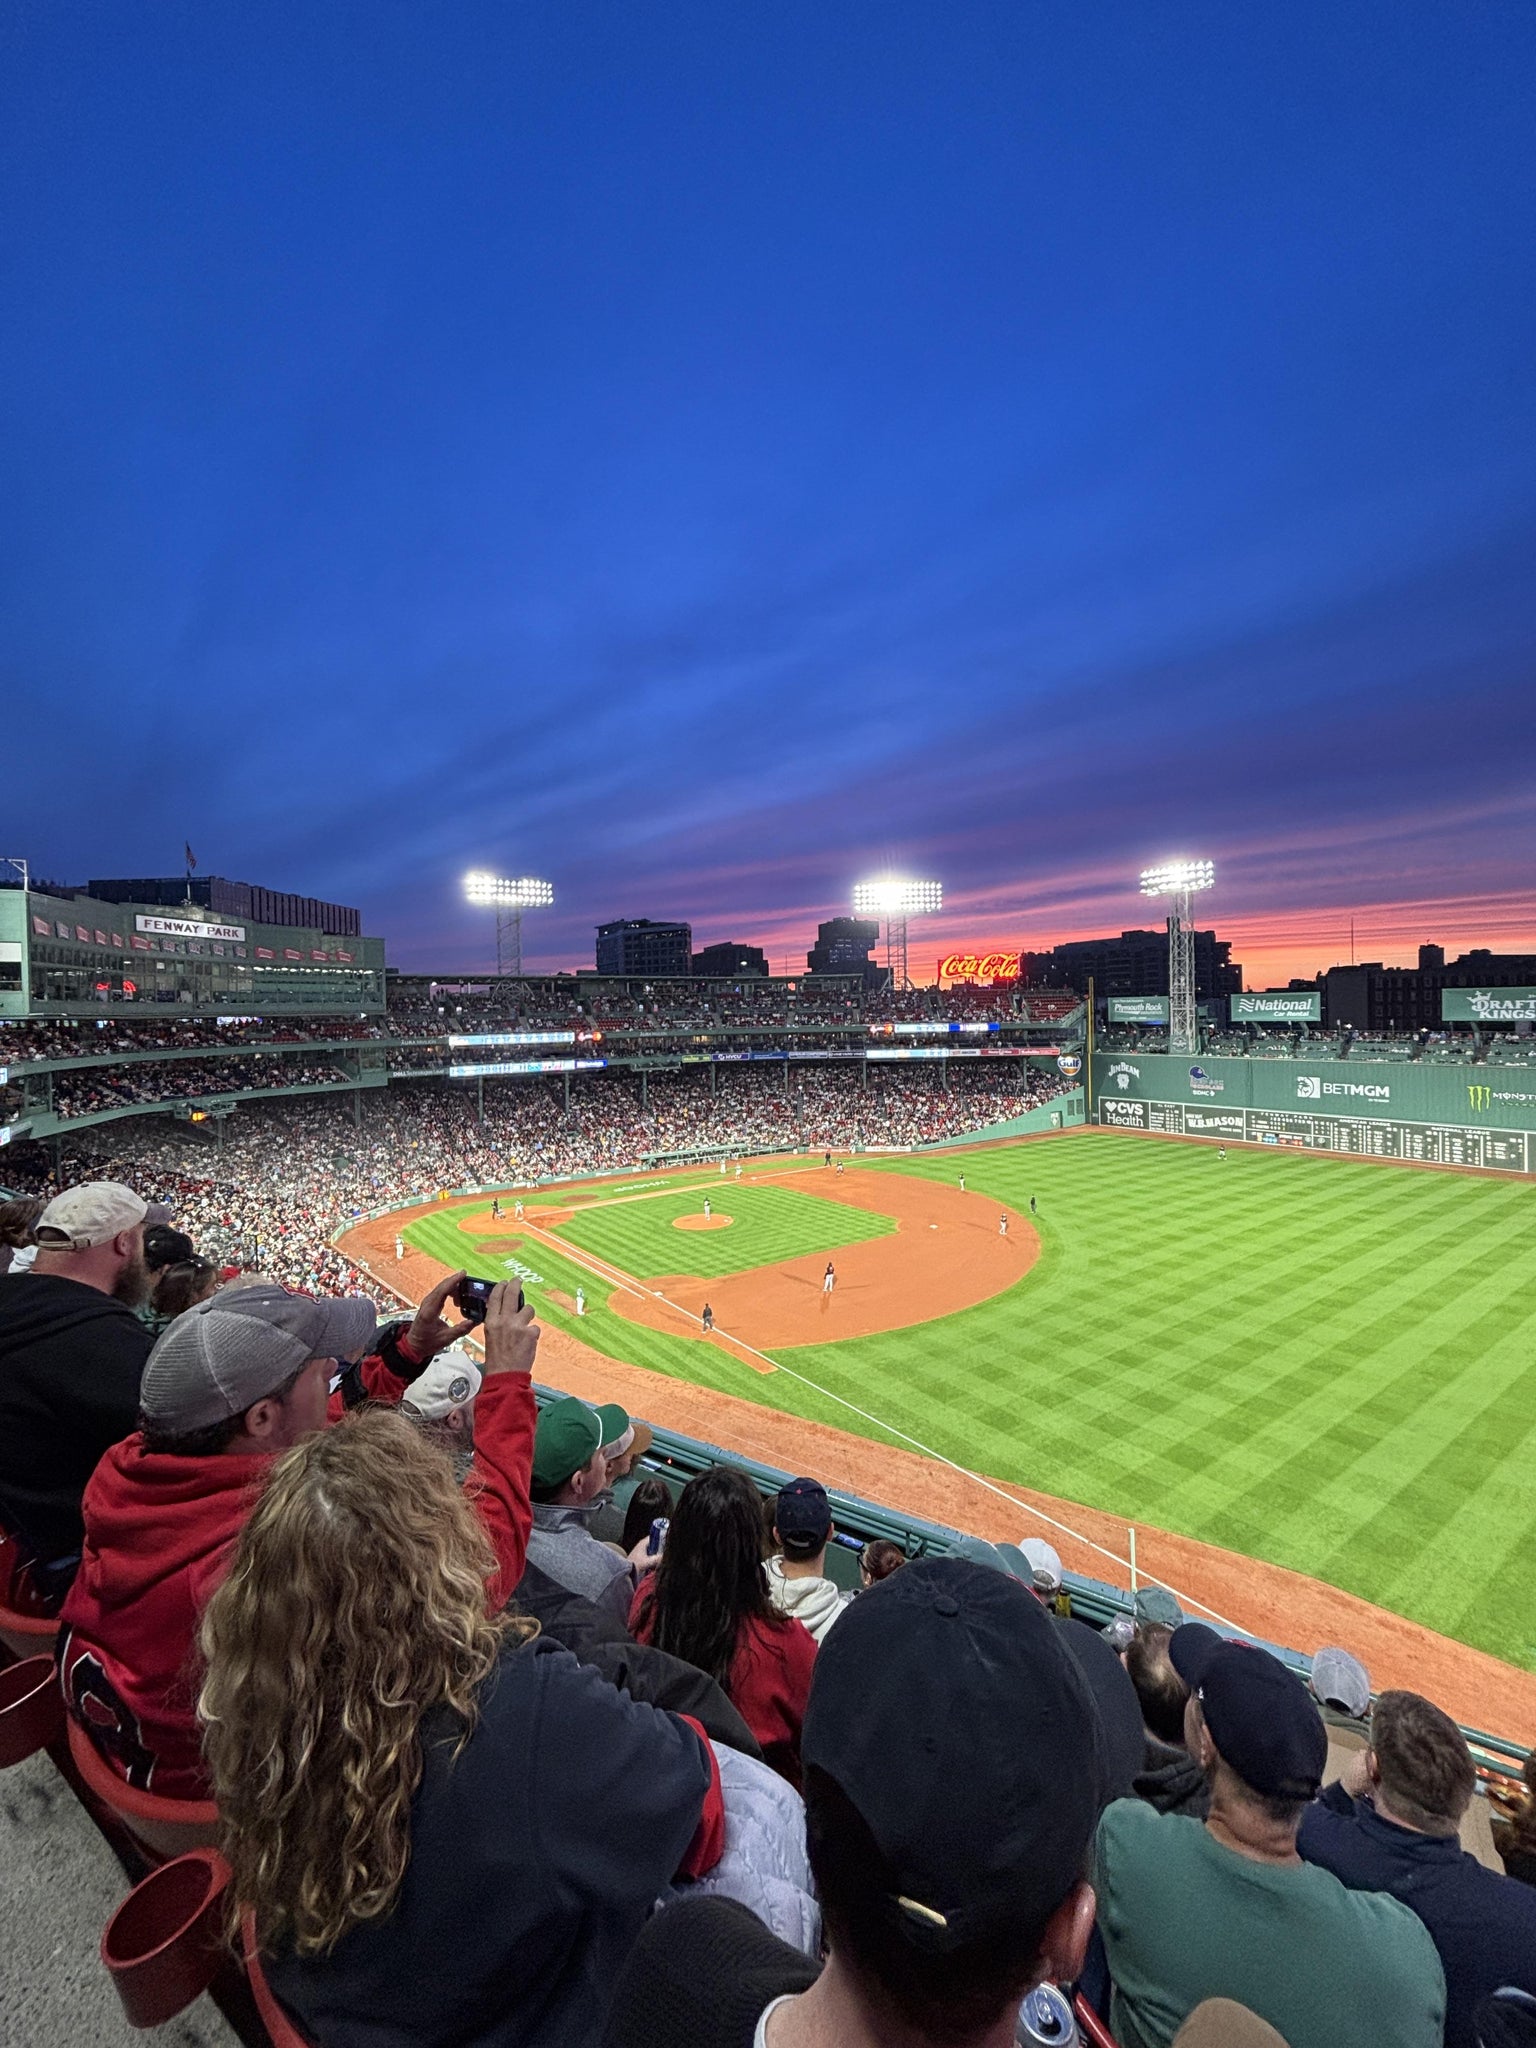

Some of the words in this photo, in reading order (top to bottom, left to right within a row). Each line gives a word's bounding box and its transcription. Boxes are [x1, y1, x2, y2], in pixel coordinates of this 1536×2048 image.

[144, 919, 200, 934] FENWAY
[207, 926, 239, 938] PARK
[941, 953, 1021, 979] Coca-Cola
[1114, 1003, 1144, 1013] Plymouth
[1145, 1002, 1162, 1010] Rock
[1254, 999, 1312, 1011] National
[1471, 1000, 1536, 1012] DRAFT
[1479, 1009, 1536, 1019] KINGS
[1059, 1059, 1080, 1067] Gulf
[1108, 1063, 1120, 1077] JIM
[1120, 1061, 1140, 1079] BEAM
[1323, 1082, 1390, 1097] BETMGM
[1117, 1102, 1144, 1115] CVS
[1106, 1112, 1144, 1127] Health
[500, 1258, 545, 1283] WHOOP
